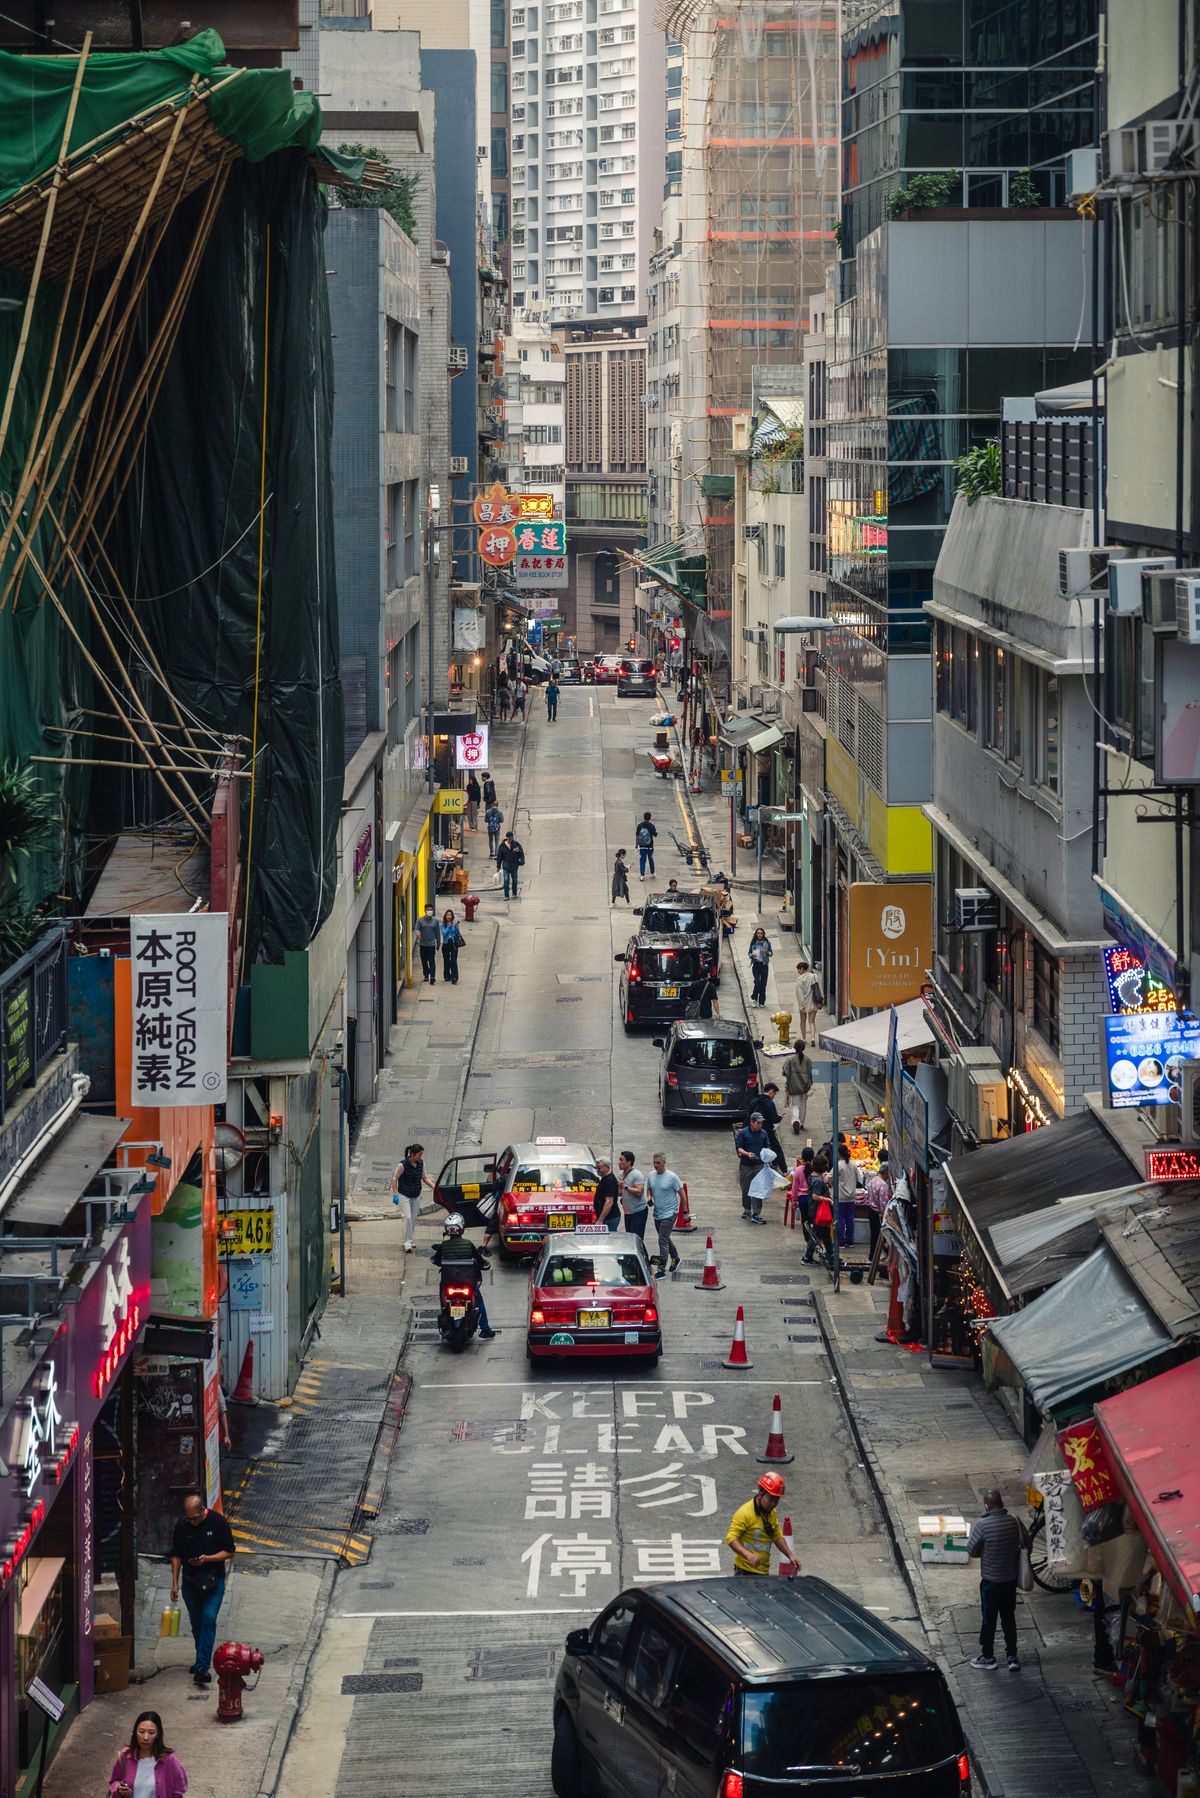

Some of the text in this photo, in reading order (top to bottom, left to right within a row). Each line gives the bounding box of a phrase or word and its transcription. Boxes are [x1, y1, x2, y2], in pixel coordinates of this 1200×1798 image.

[485, 532, 510, 560] 押
[443, 798, 460, 806] JHC
[136, 929, 173, 1092] 本原純素
[176, 930, 197, 1089] ROOT VEGAN
[551, 1221, 572, 1229] 6447
[577, 1225, 607, 1233] TAXI
[520, 1391, 716, 1420] KEEP
[491, 1423, 749, 1455] CLEAR
[524, 1462, 718, 1520] 請勿
[521, 1533, 731, 1598] 停車
